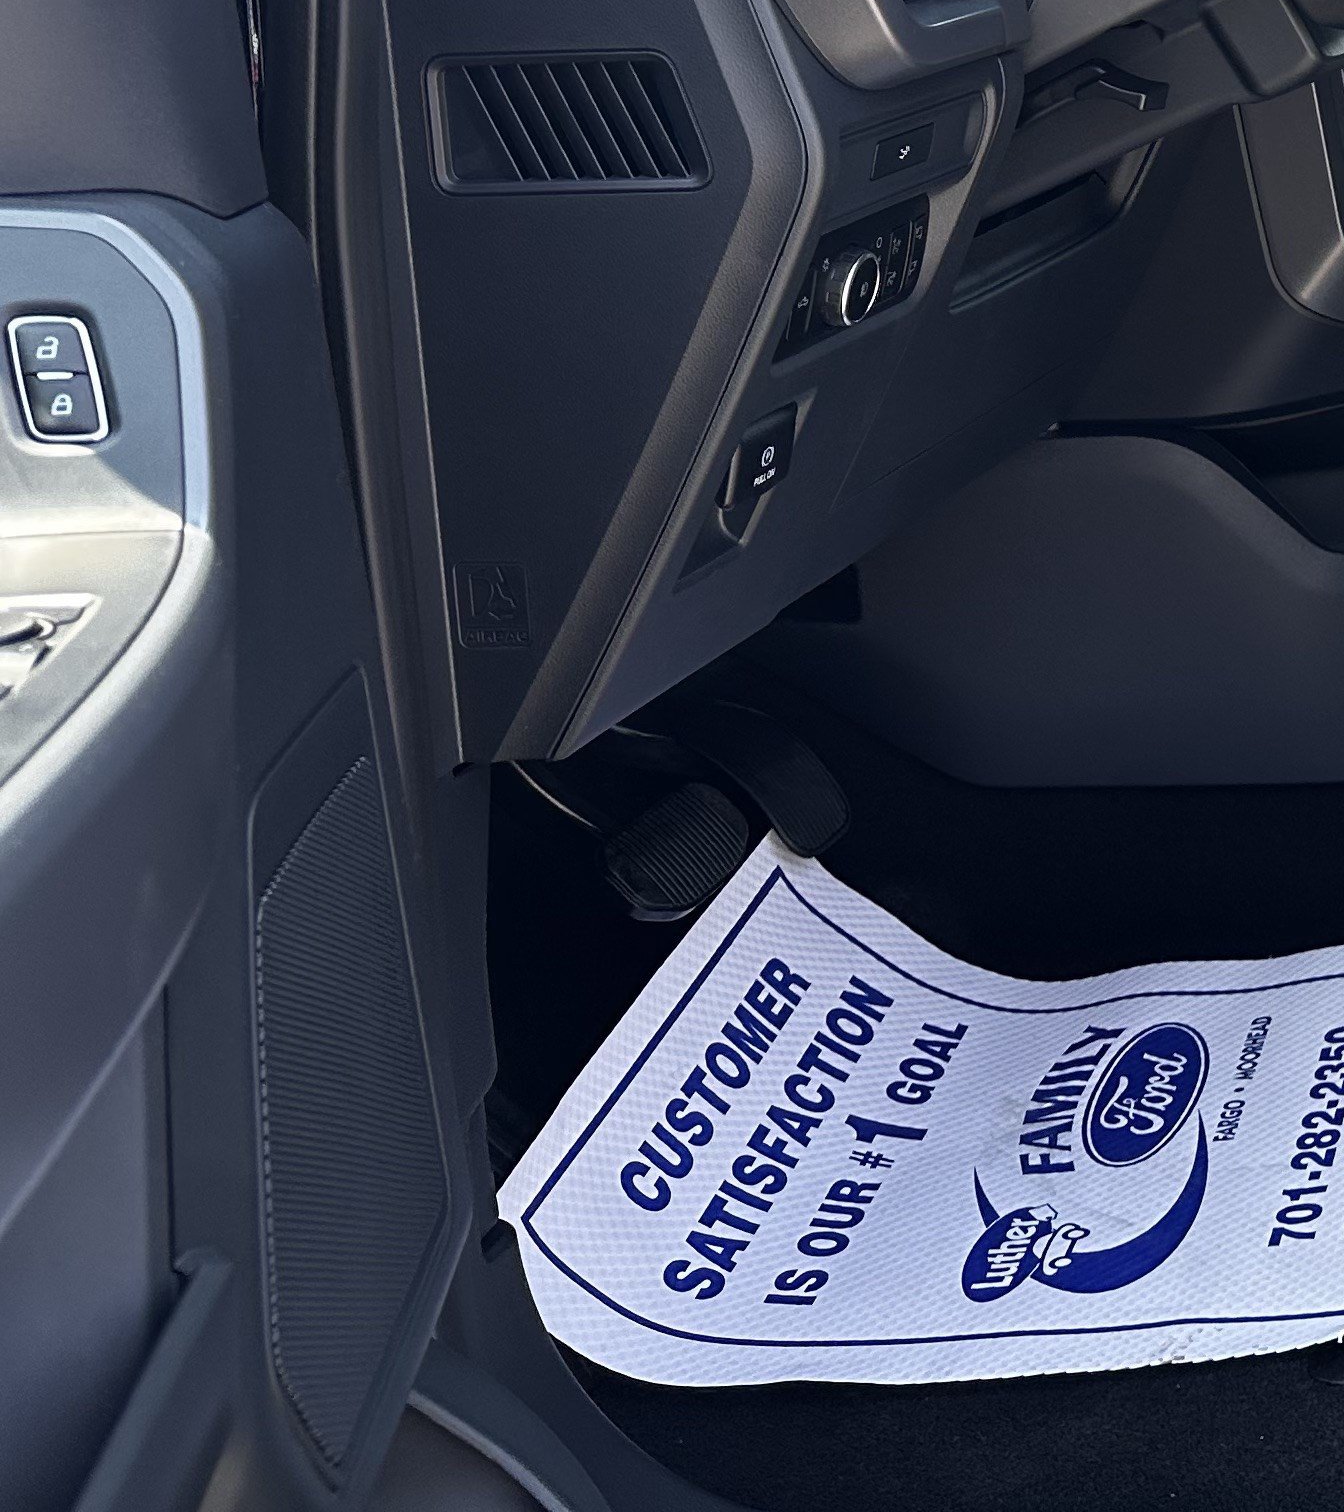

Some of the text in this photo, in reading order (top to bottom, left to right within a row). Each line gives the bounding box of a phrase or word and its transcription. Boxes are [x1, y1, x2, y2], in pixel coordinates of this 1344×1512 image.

[620, 958, 812, 1212] CUSTOMER
[662, 975, 896, 1300] SATISFACTION
[1018, 1024, 1128, 1176] FAMILY
[1099, 1051, 1188, 1137] Ford
[1212, 1014, 1273, 1142] FARGO MOORHEAD
[763, 1021, 969, 1306] IS OUR #1 GOAL
[970, 1217, 1040, 1290] Luther
